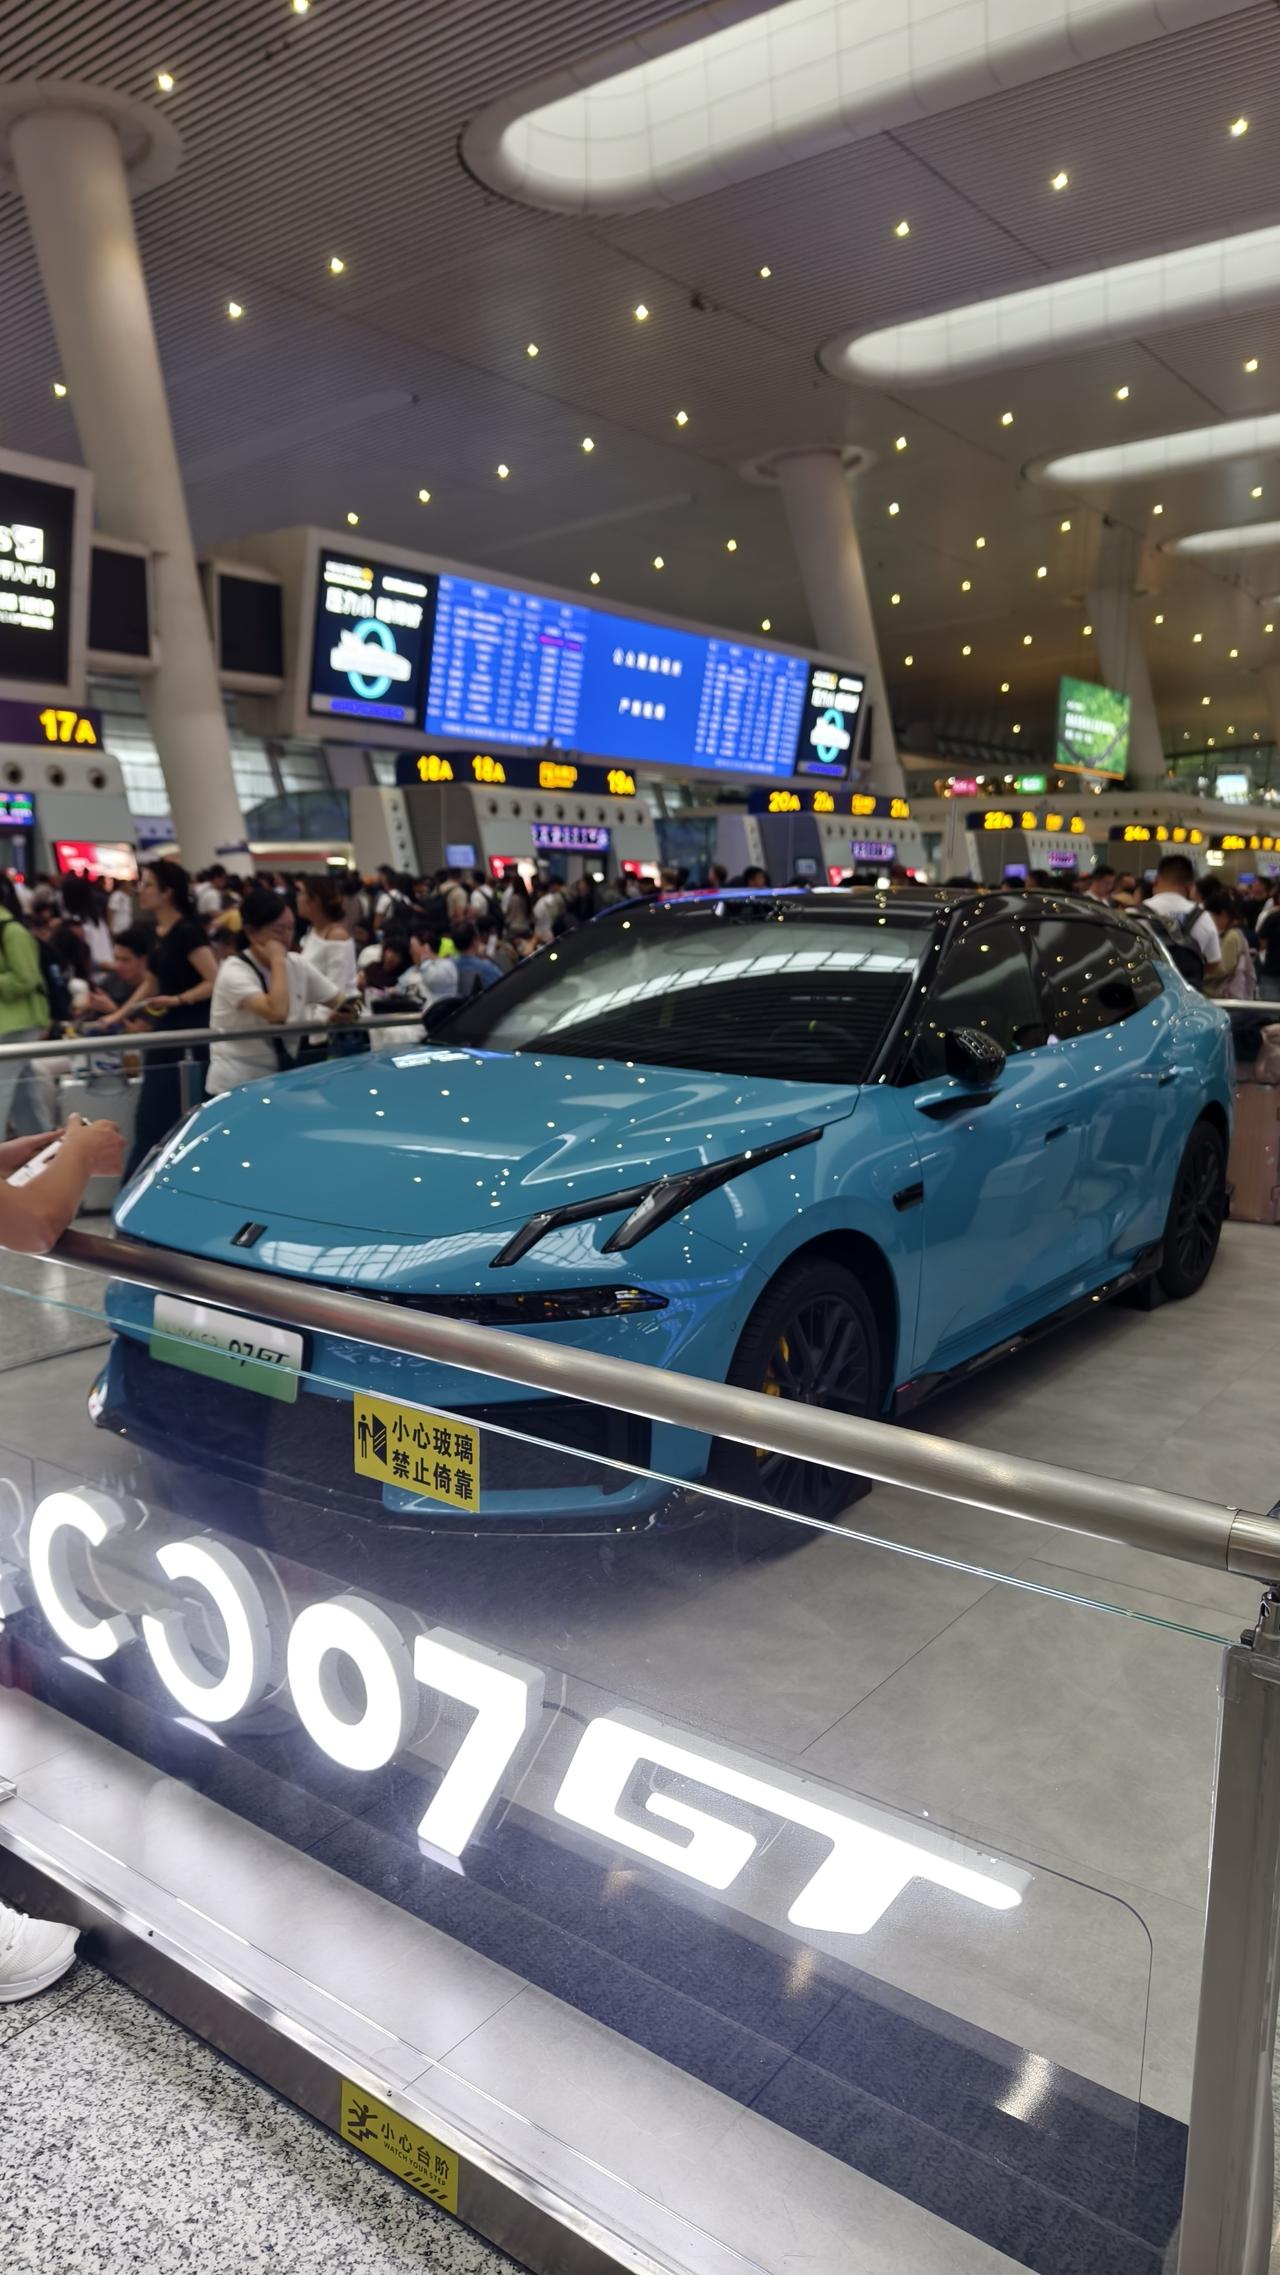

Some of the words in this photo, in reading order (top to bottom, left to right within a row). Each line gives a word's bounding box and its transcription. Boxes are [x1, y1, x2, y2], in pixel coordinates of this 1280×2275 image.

[39, 708, 97, 744] 17A
[391, 1414, 474, 1466] 小心玻璃
[391, 1448, 474, 1501] 禁止倚靠
[380, 2122, 450, 2180] 小心台阶
[384, 2142, 408, 2162] WATCH
[409, 2158, 428, 2176] YOUR
[429, 2172, 446, 2186] STEP
